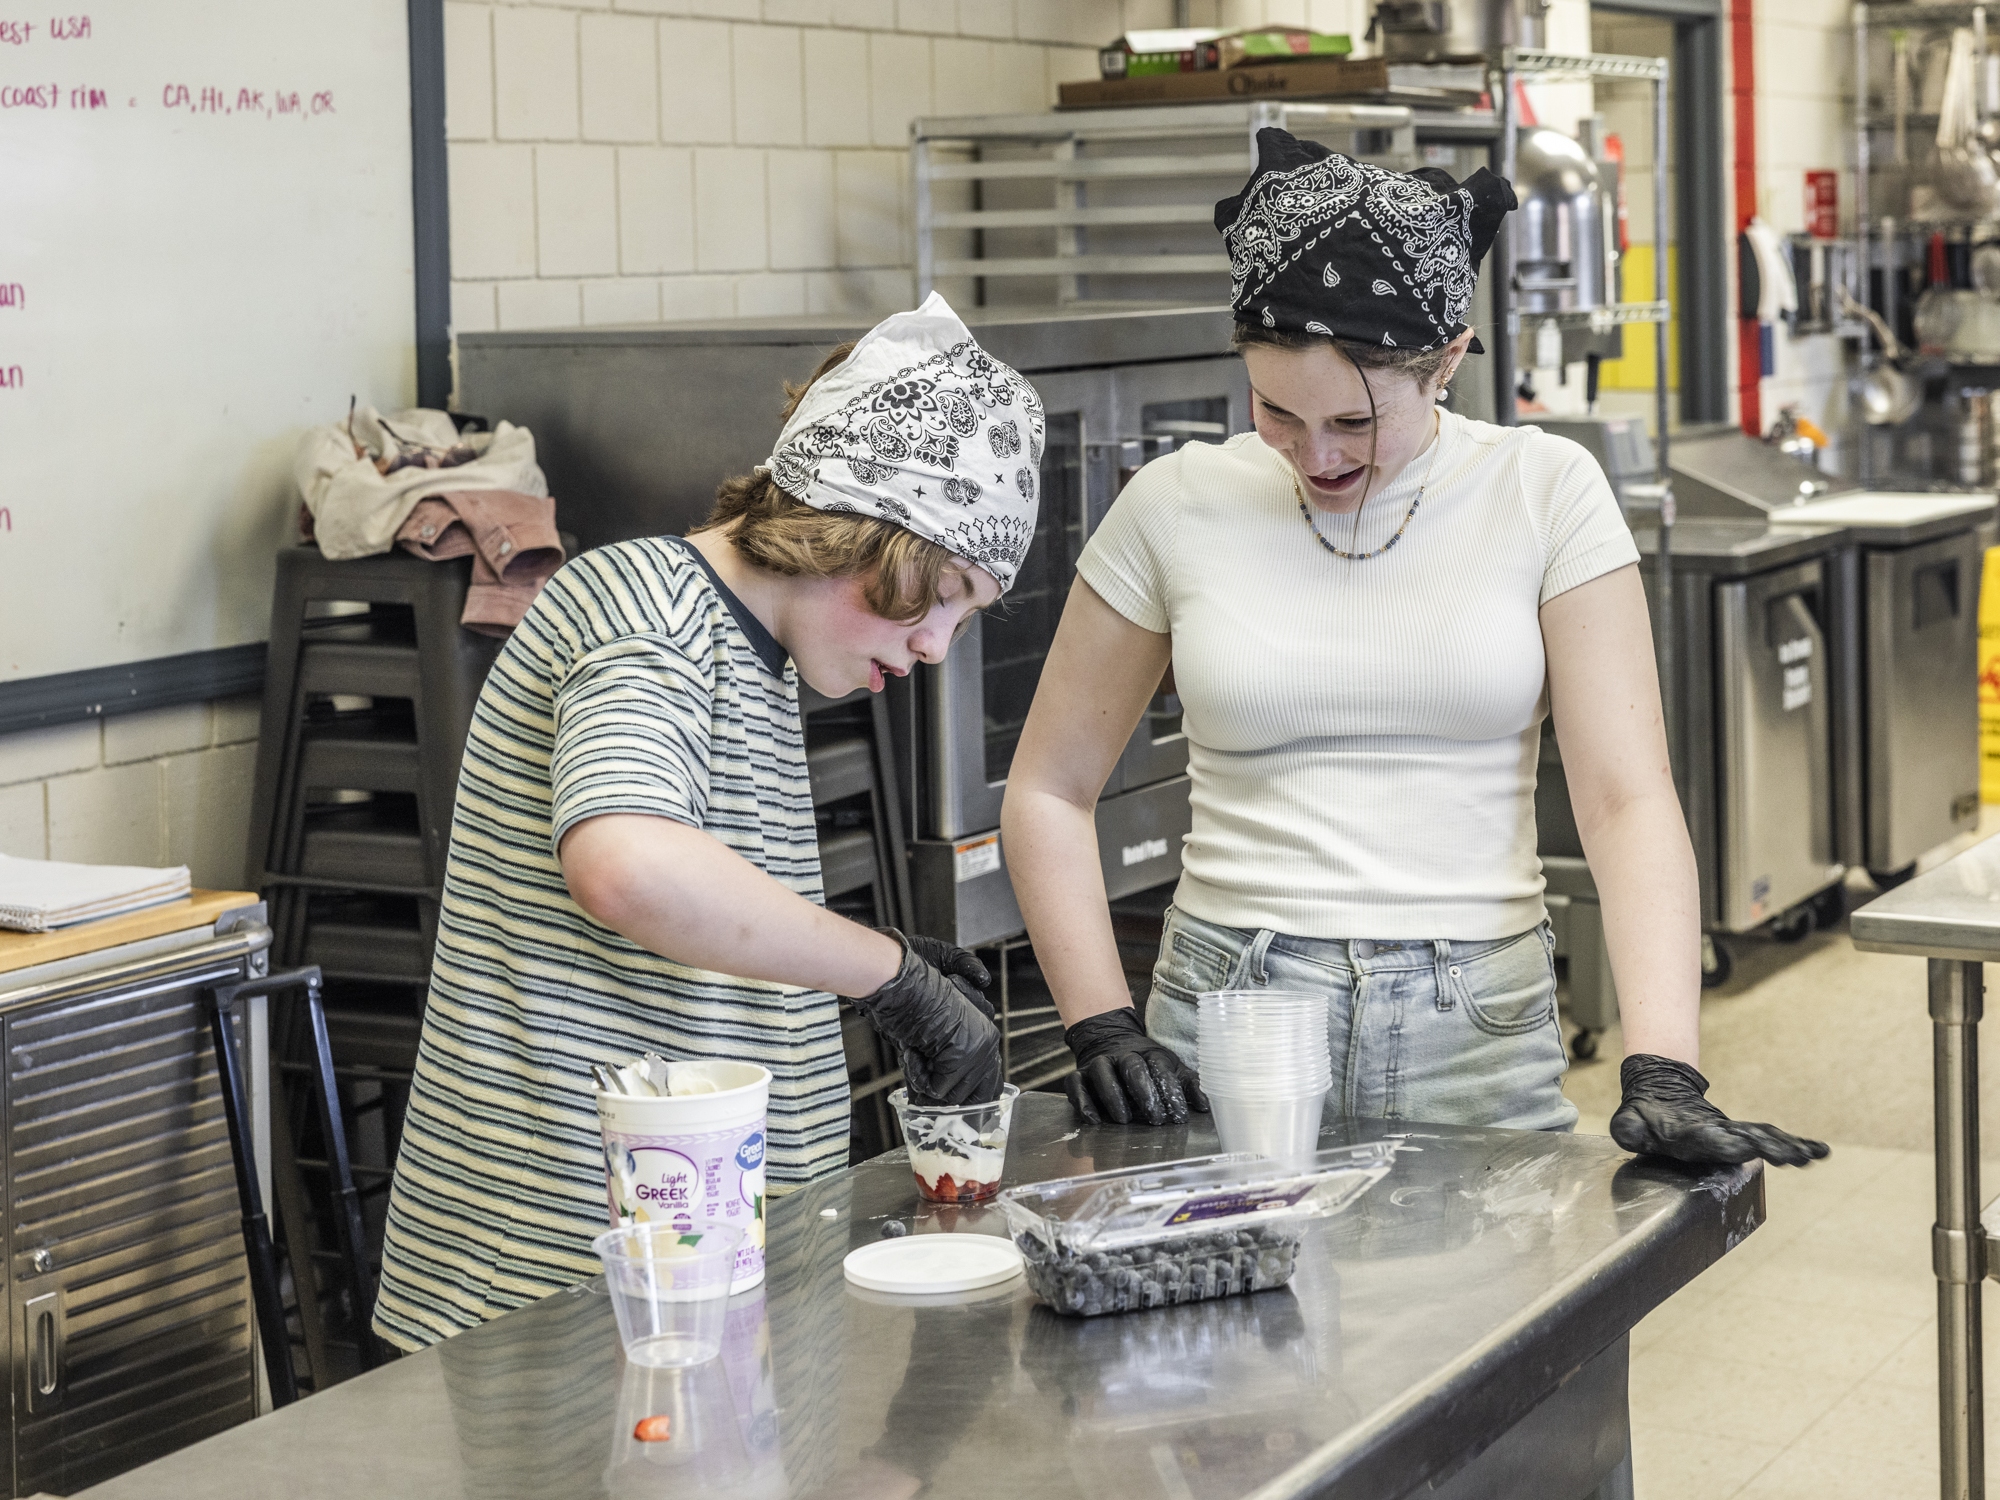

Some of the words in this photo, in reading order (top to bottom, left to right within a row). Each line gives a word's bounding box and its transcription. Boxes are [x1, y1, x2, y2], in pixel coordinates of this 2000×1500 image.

[51, 15, 92, 40] USA
[1, 83, 61, 109] coast
[71, 84, 108, 110] rim
[740, 1140, 763, 1159] Great
[746, 1151, 763, 1164] Value
[661, 1172, 688, 1188] Light
[636, 1184, 688, 1201] GREEK
[658, 1201, 689, 1210] Vanilla
